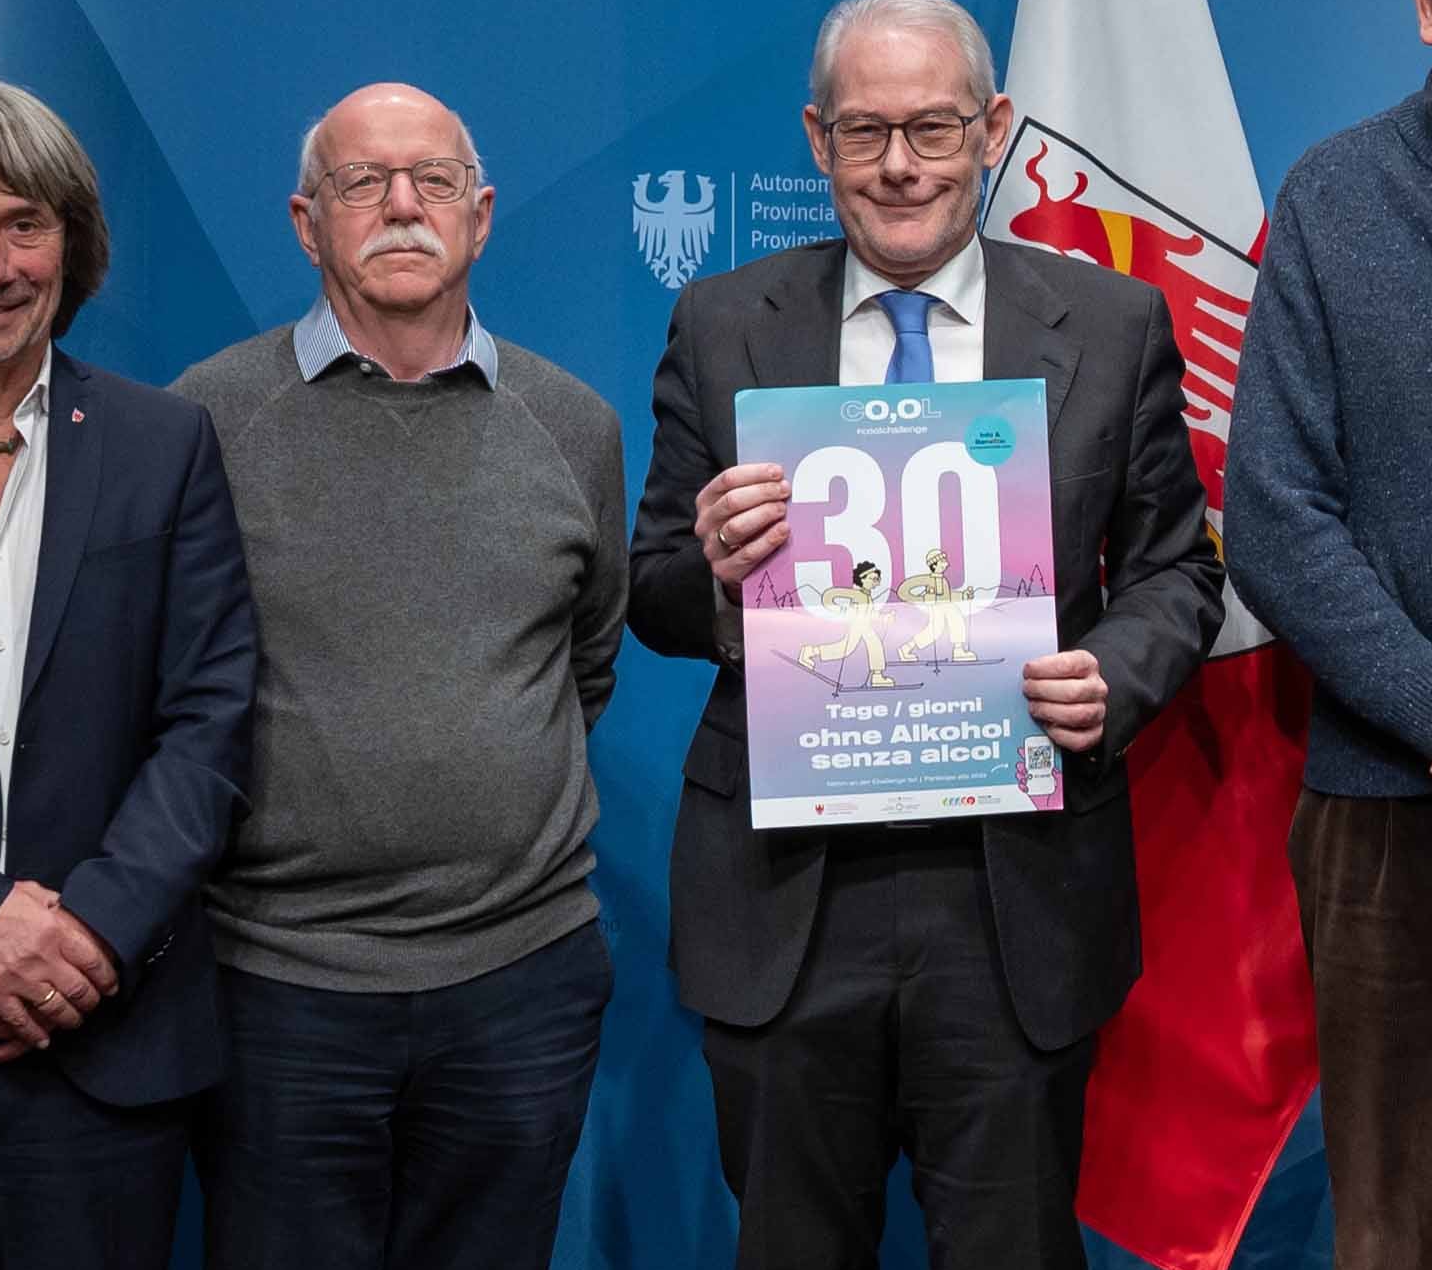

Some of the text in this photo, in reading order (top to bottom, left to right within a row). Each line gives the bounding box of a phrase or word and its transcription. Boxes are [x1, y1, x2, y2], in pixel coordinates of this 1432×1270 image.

[752, 201, 834, 221] Provincia
[791, 442, 1000, 618] 30
[826, 704, 888, 720] Tage
[909, 698, 981, 717] giorni
[800, 719, 1010, 747] ohne Alkohol
[811, 742, 999, 769] senza alcol
